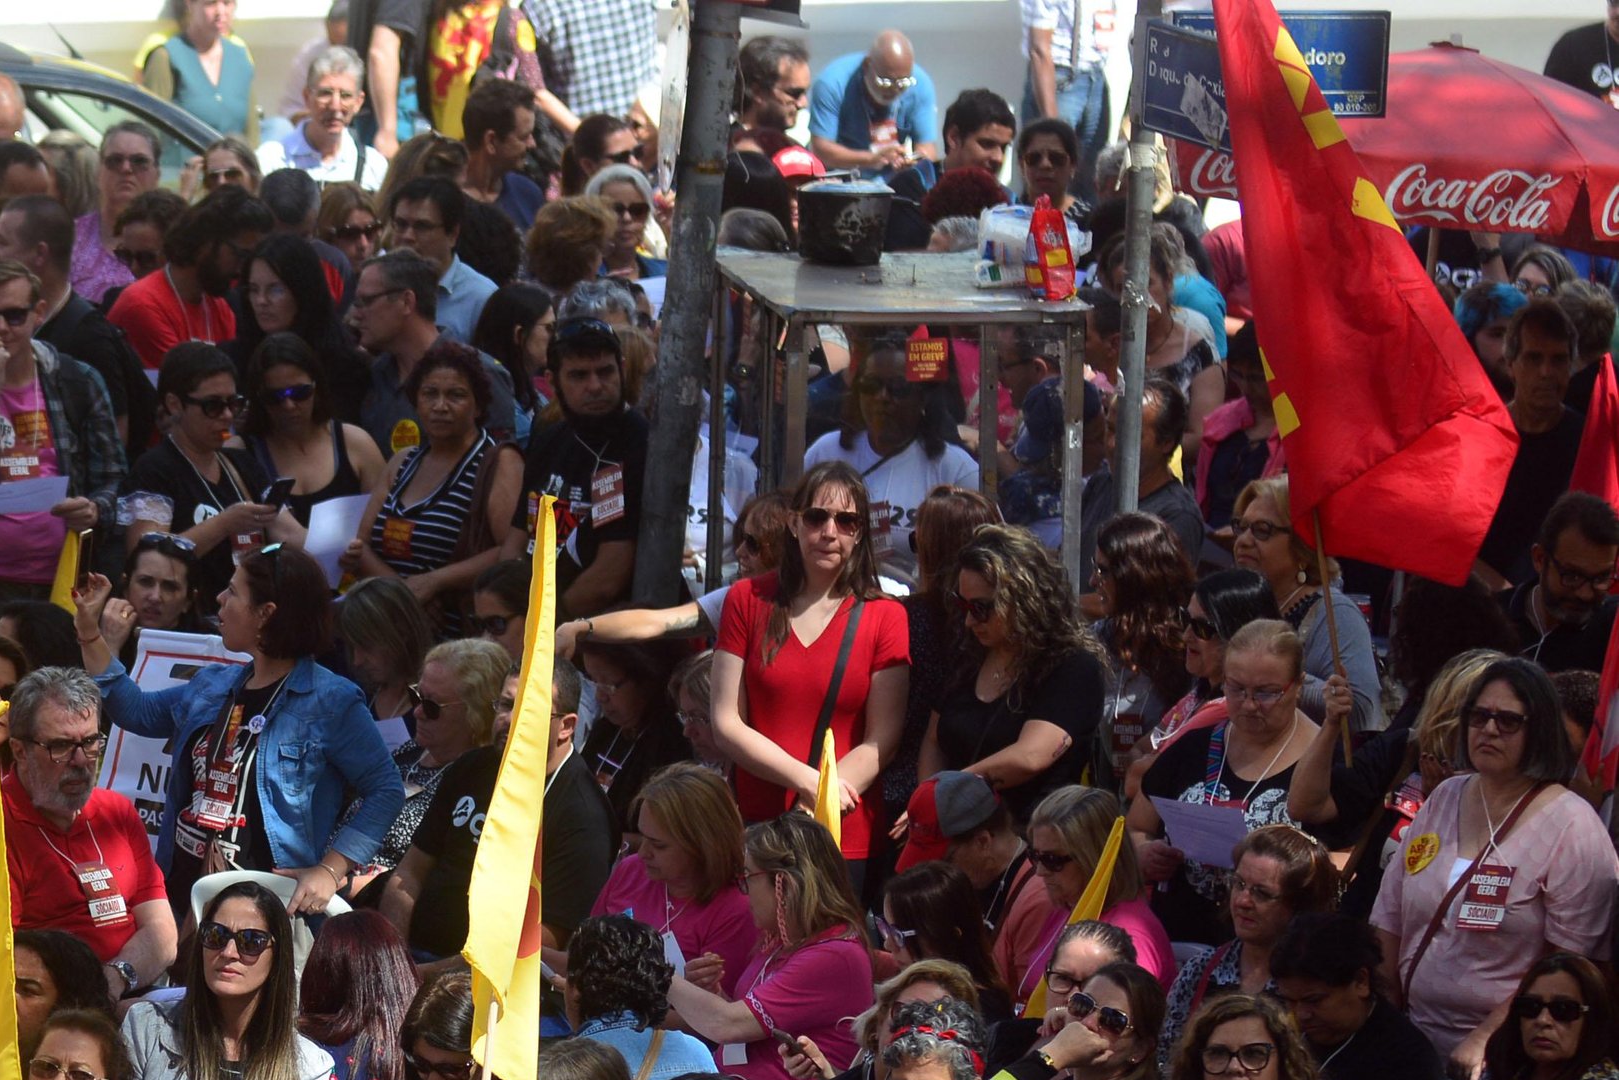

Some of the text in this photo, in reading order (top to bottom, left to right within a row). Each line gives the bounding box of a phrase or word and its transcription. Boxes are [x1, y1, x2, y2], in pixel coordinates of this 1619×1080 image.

[1385, 163, 1565, 229] Coca-Cola
[1470, 873, 1512, 887] ASSEMBLEIA
[1477, 884, 1498, 897] GERAL
